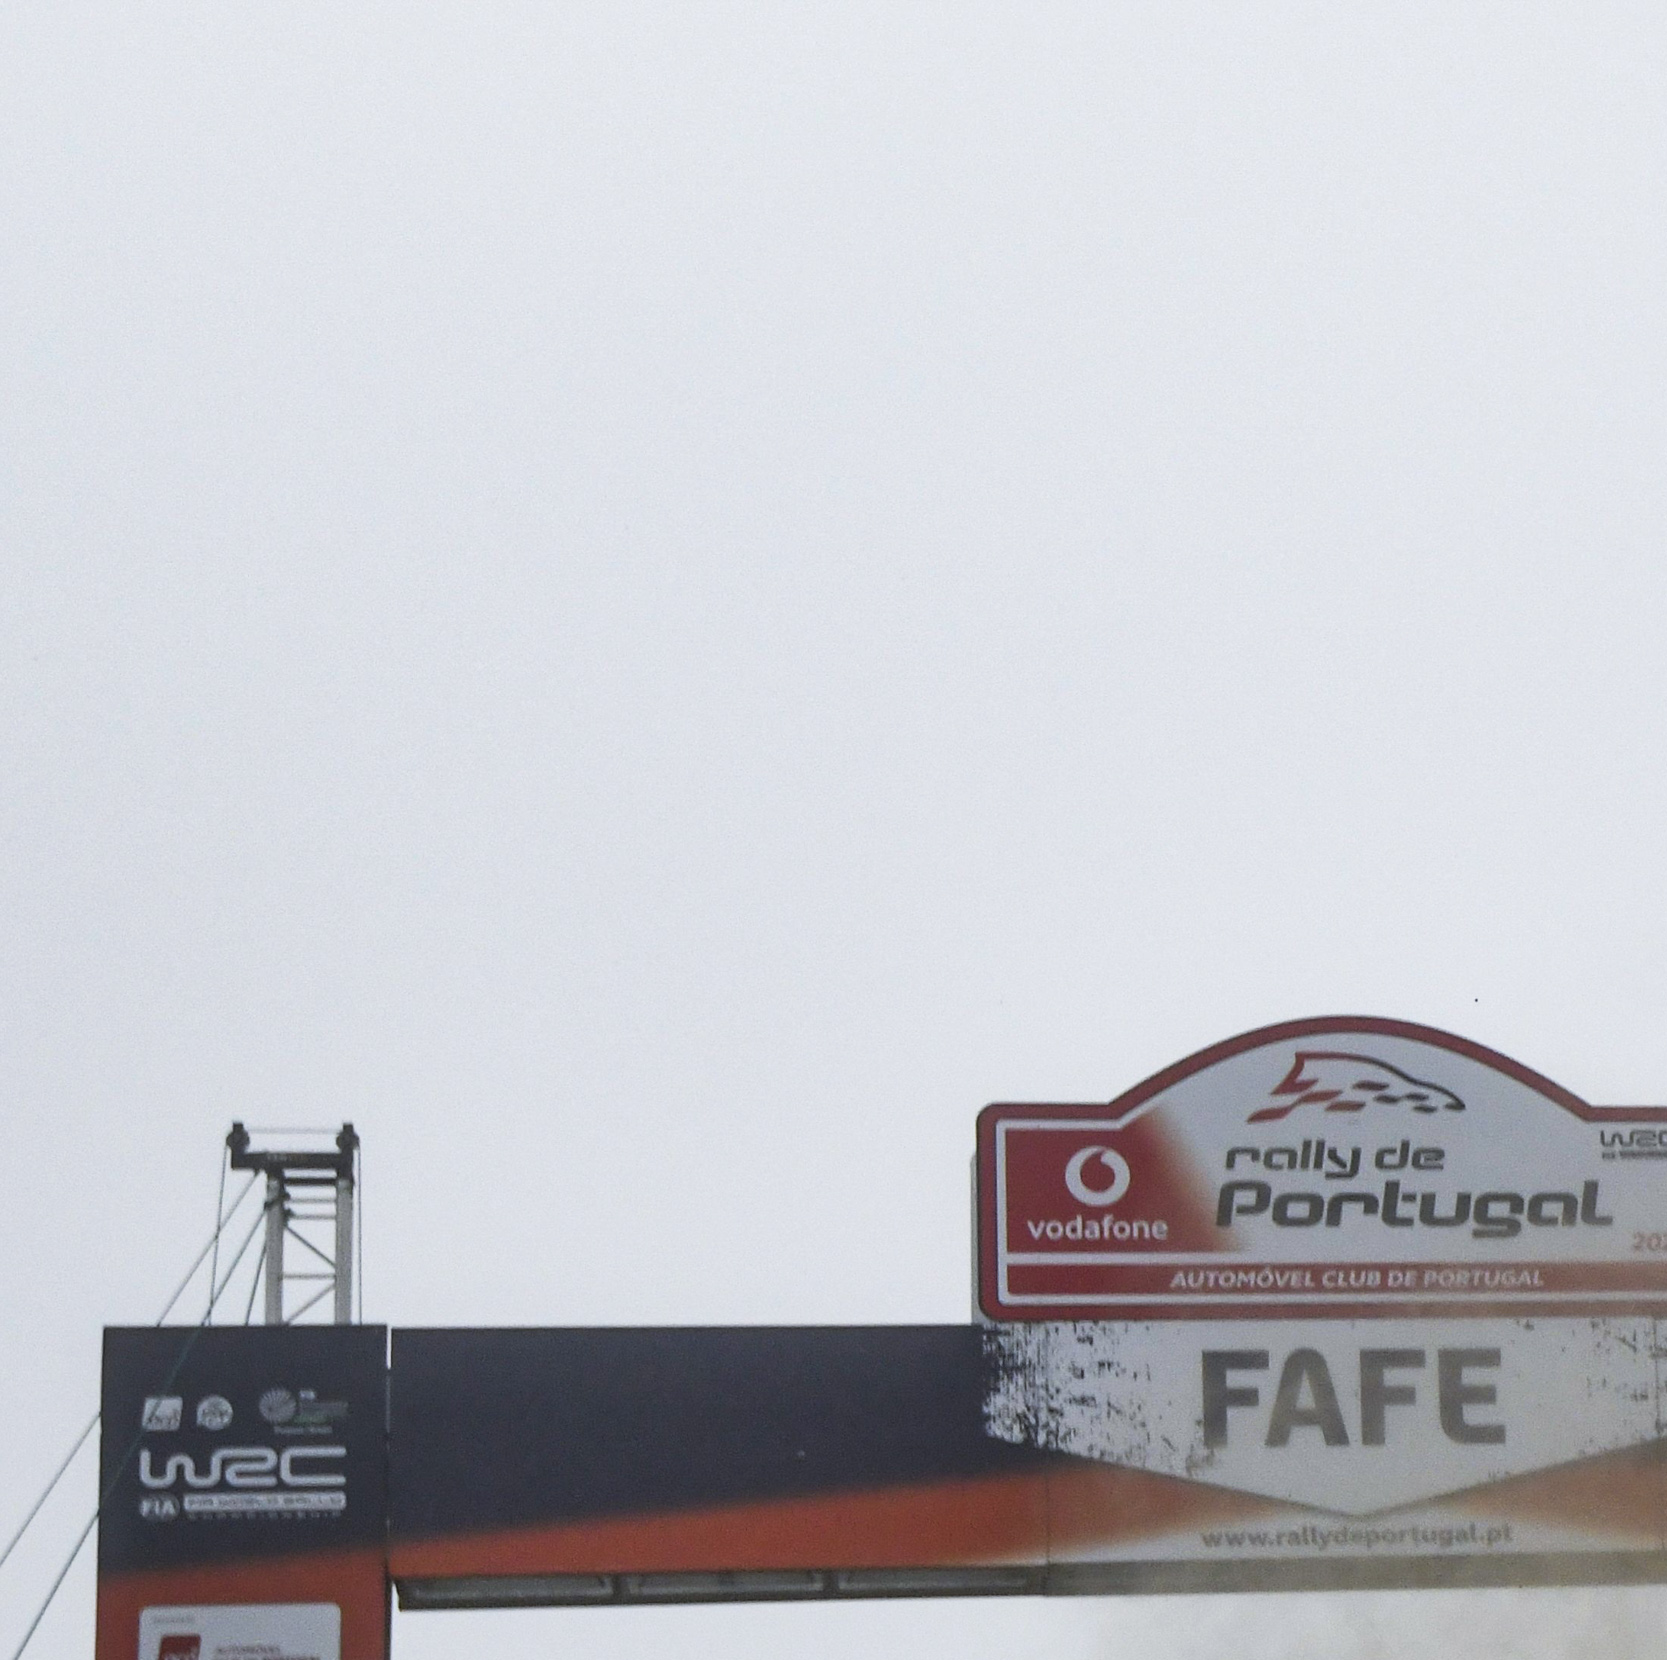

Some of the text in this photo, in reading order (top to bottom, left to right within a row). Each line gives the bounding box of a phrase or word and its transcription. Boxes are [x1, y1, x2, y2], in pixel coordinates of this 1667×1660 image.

[1224, 1138, 1446, 1179] rally de
[1027, 1214, 1169, 1241] vodafone
[1216, 1179, 1614, 1238] Portugal
[1169, 1266, 1544, 1288] AUTOMÓVEL CLUB DE PORTUGAL
[1201, 1348, 1507, 1447] FAFE
[140, 1446, 347, 1488] WRC
[1201, 1522, 1513, 1549] www.rallydeportugal.pt
